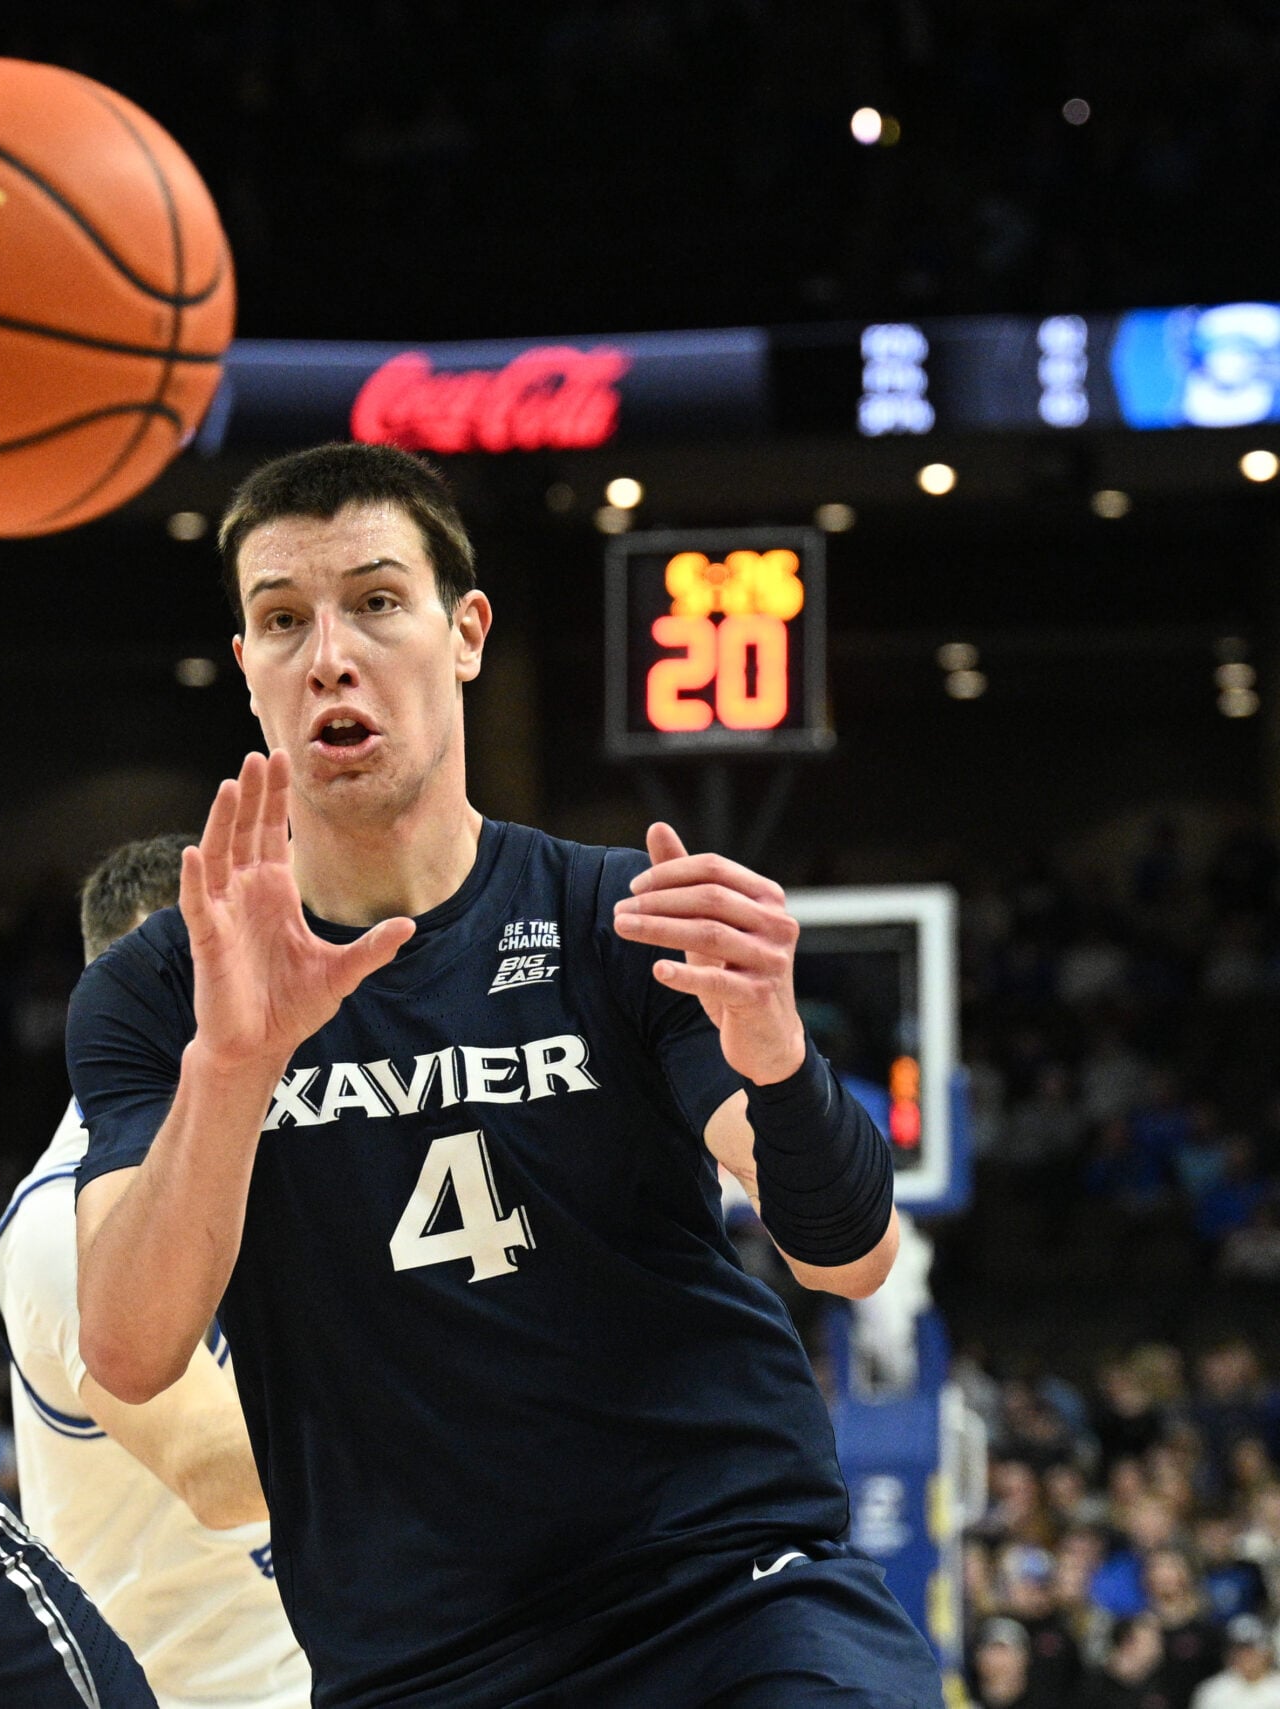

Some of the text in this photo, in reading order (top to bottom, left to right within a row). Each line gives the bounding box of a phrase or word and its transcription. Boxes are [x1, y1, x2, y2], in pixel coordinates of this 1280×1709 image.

[647, 615, 788, 732] 20
[504, 921, 558, 937] BE THE
[498, 934, 561, 952] CHANGE
[498, 954, 546, 972] BIG
[491, 966, 560, 987] EAST
[260, 1034, 601, 1132] XAVIER
[389, 1129, 537, 1284] 4
